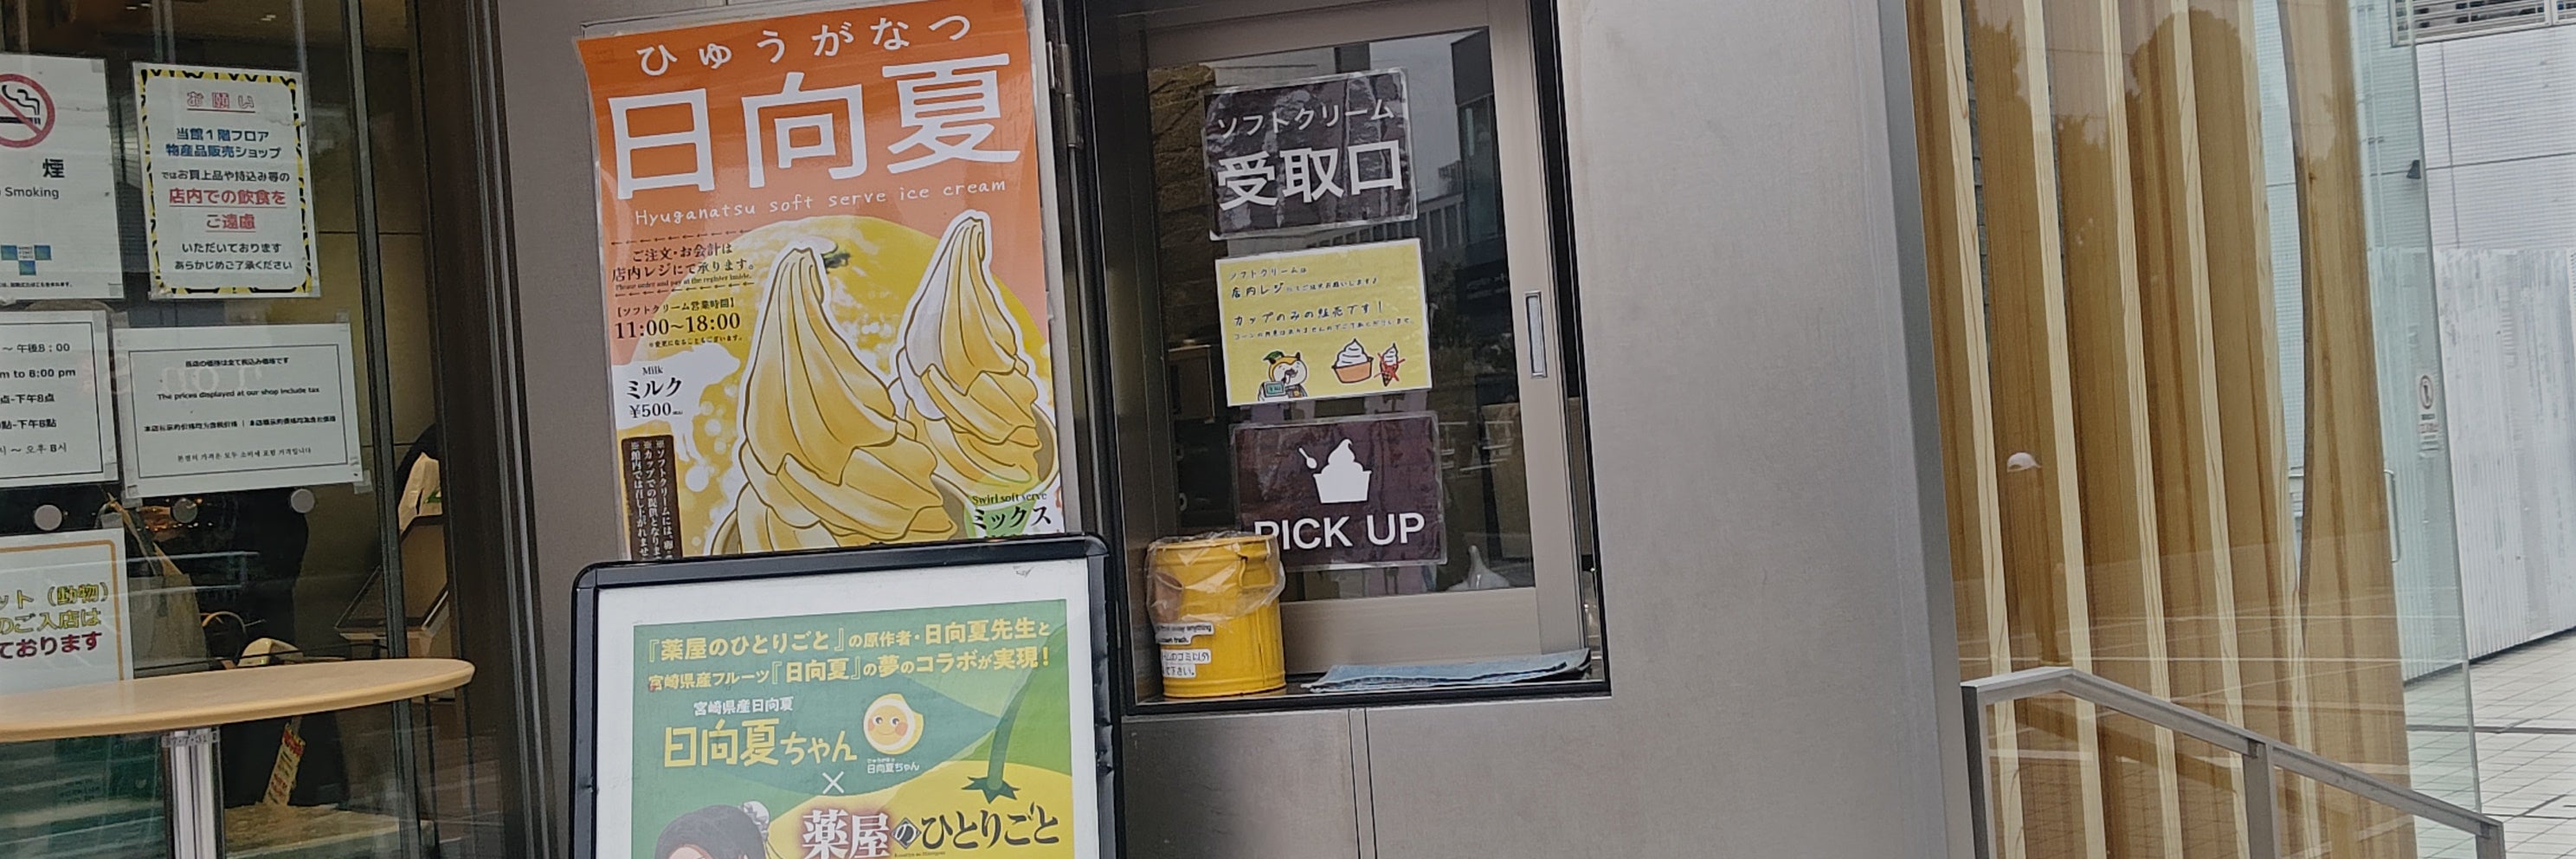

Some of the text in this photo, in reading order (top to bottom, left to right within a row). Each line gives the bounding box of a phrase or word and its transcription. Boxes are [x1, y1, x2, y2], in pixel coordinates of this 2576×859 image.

[635, 13, 971, 76] ひゅうがなつ
[186, 91, 255, 109] お願い
[607, 53, 1021, 200] 日向夏
[1218, 98, 1394, 139] ソフトクリーム
[165, 143, 282, 159] 物産品販売ショップ
[42, 158, 65, 178] 煙
[1217, 139, 1403, 211] 受取口
[4, 186, 60, 200] Smoking
[169, 186, 287, 205] 店内での飲食を
[634, 178, 1006, 226] Hyuganatsu soft serve ice cream
[206, 213, 255, 229] ご遠慮
[182, 242, 282, 254] いただいております
[633, 242, 733, 262] ご注文・お会計は
[174, 260, 293, 271] あらかじめご了承ください
[611, 258, 755, 282] 店内レジにて承ります。
[617, 296, 735, 318] 【ソフトクリーム営業時間】
[14, 369, 25, 378] to
[58, 368, 76, 379] pm
[641, 365, 664, 376] Milk
[174, 391, 197, 402] prices
[199, 390, 235, 400] displayed
[261, 388, 279, 397] shop
[626, 377, 682, 400] ミルク
[629, 402, 672, 419] ¥500
[631, 441, 649, 560] ※館内では召し上がれませ
[972, 494, 998, 505] Swirl
[1001, 492, 1019, 502] soft
[971, 505, 1052, 530] ミックス
[1254, 512, 1426, 551] PICK UP
[0, 630, 103, 659] ております
[692, 695, 795, 717] 宮崎県産日向夏
[664, 717, 858, 768] 日向夏ちゃん
[802, 802, 1060, 859] 薬屋のひとりごと
